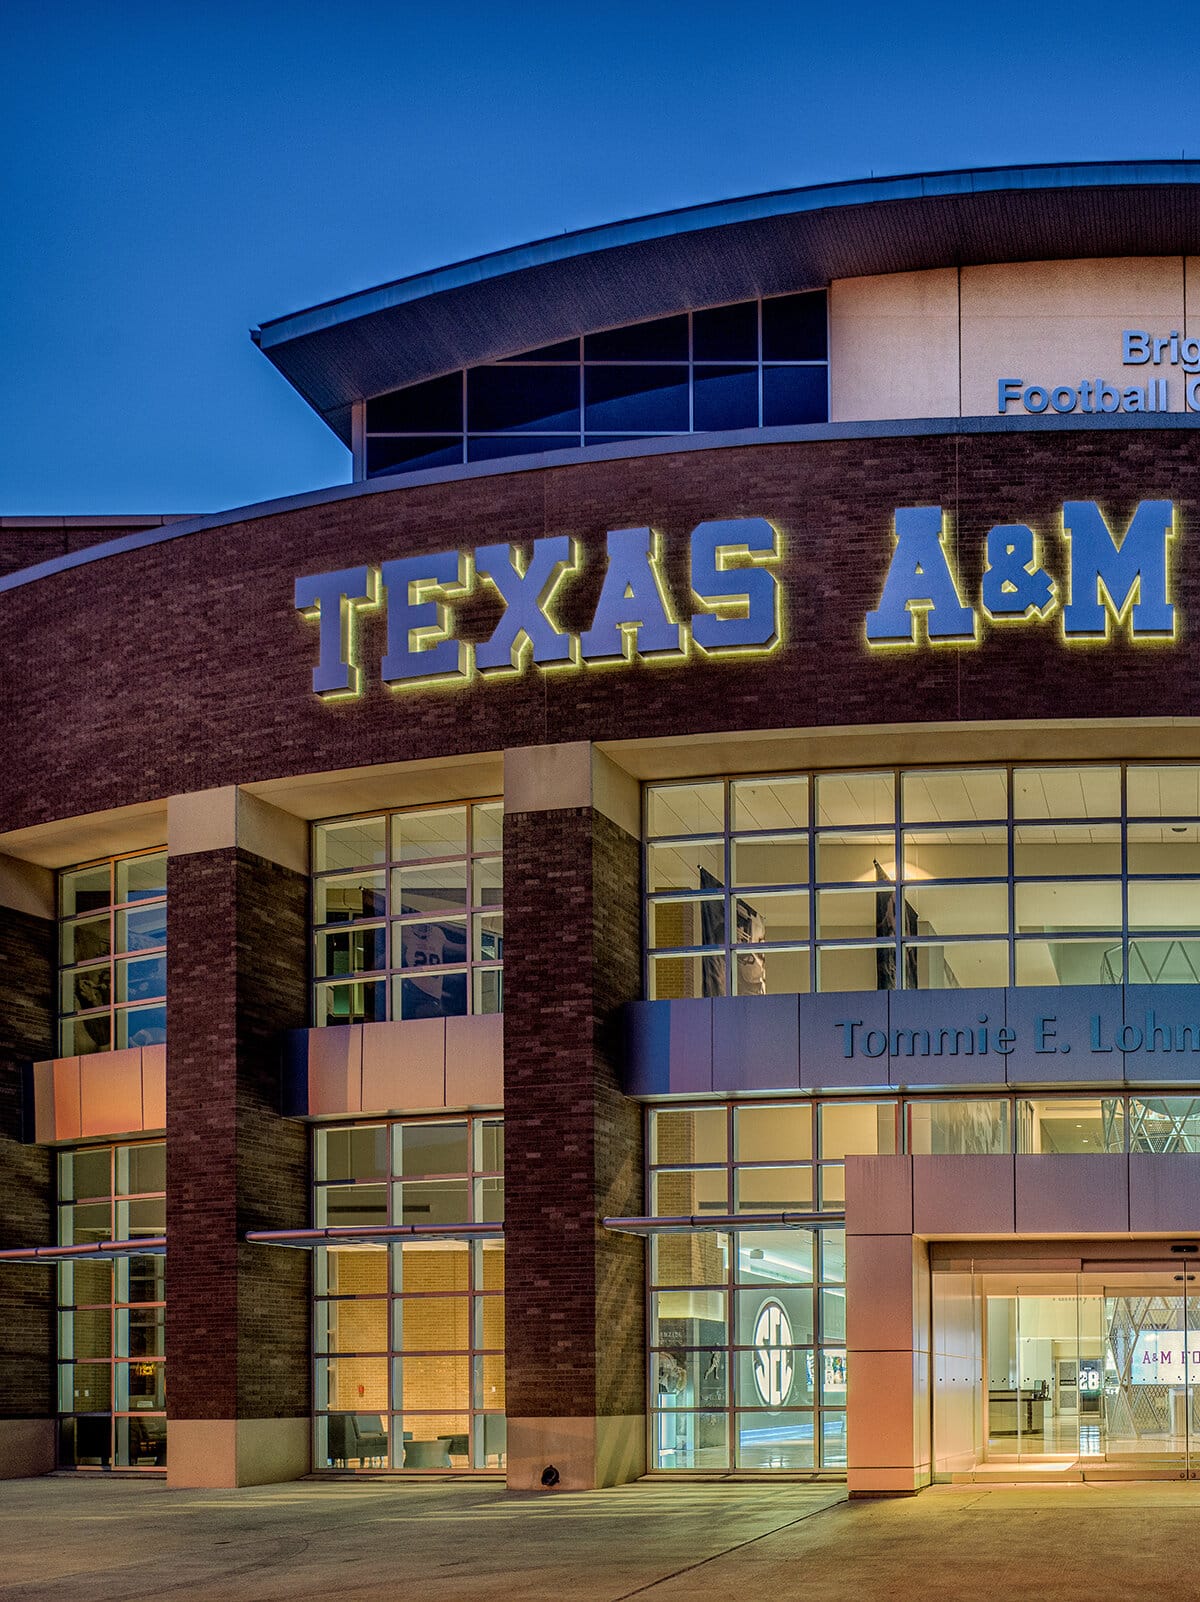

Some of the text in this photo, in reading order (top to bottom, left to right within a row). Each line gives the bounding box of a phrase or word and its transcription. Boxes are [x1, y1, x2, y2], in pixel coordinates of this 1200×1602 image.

[997, 378, 1168, 413] Football
[294, 517, 784, 698] TEXAS
[866, 500, 1177, 645] A&M
[835, 1013, 1016, 1058] Tommie
[1035, 1015, 1071, 1055] E.
[753, 1306, 794, 1406] SEC
[1142, 1350, 1172, 1365] A&M
[1079, 1370, 1100, 1390] 28
